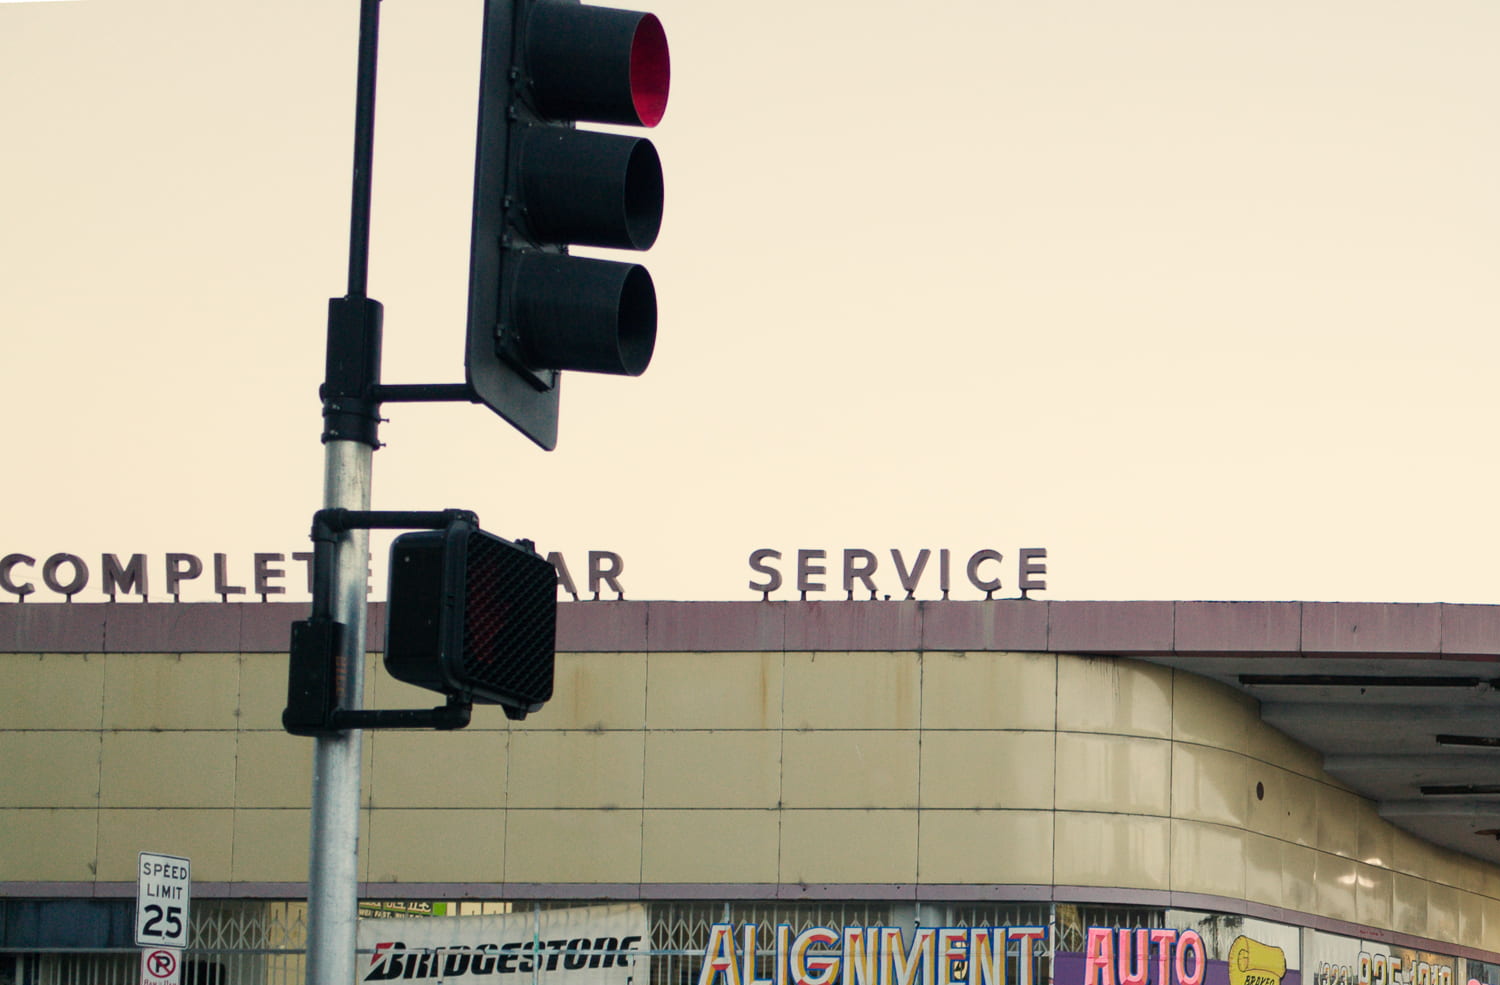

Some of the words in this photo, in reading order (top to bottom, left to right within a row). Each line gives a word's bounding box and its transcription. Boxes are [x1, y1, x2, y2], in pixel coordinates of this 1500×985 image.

[0, 552, 372, 595] COMPLET
[748, 548, 1047, 592] SERVICE
[143, 862, 187, 880] SPEED
[147, 883, 183, 900] LIMIT
[142, 904, 182, 939] 25
[364, 935, 642, 981] BRIDGESTONE
